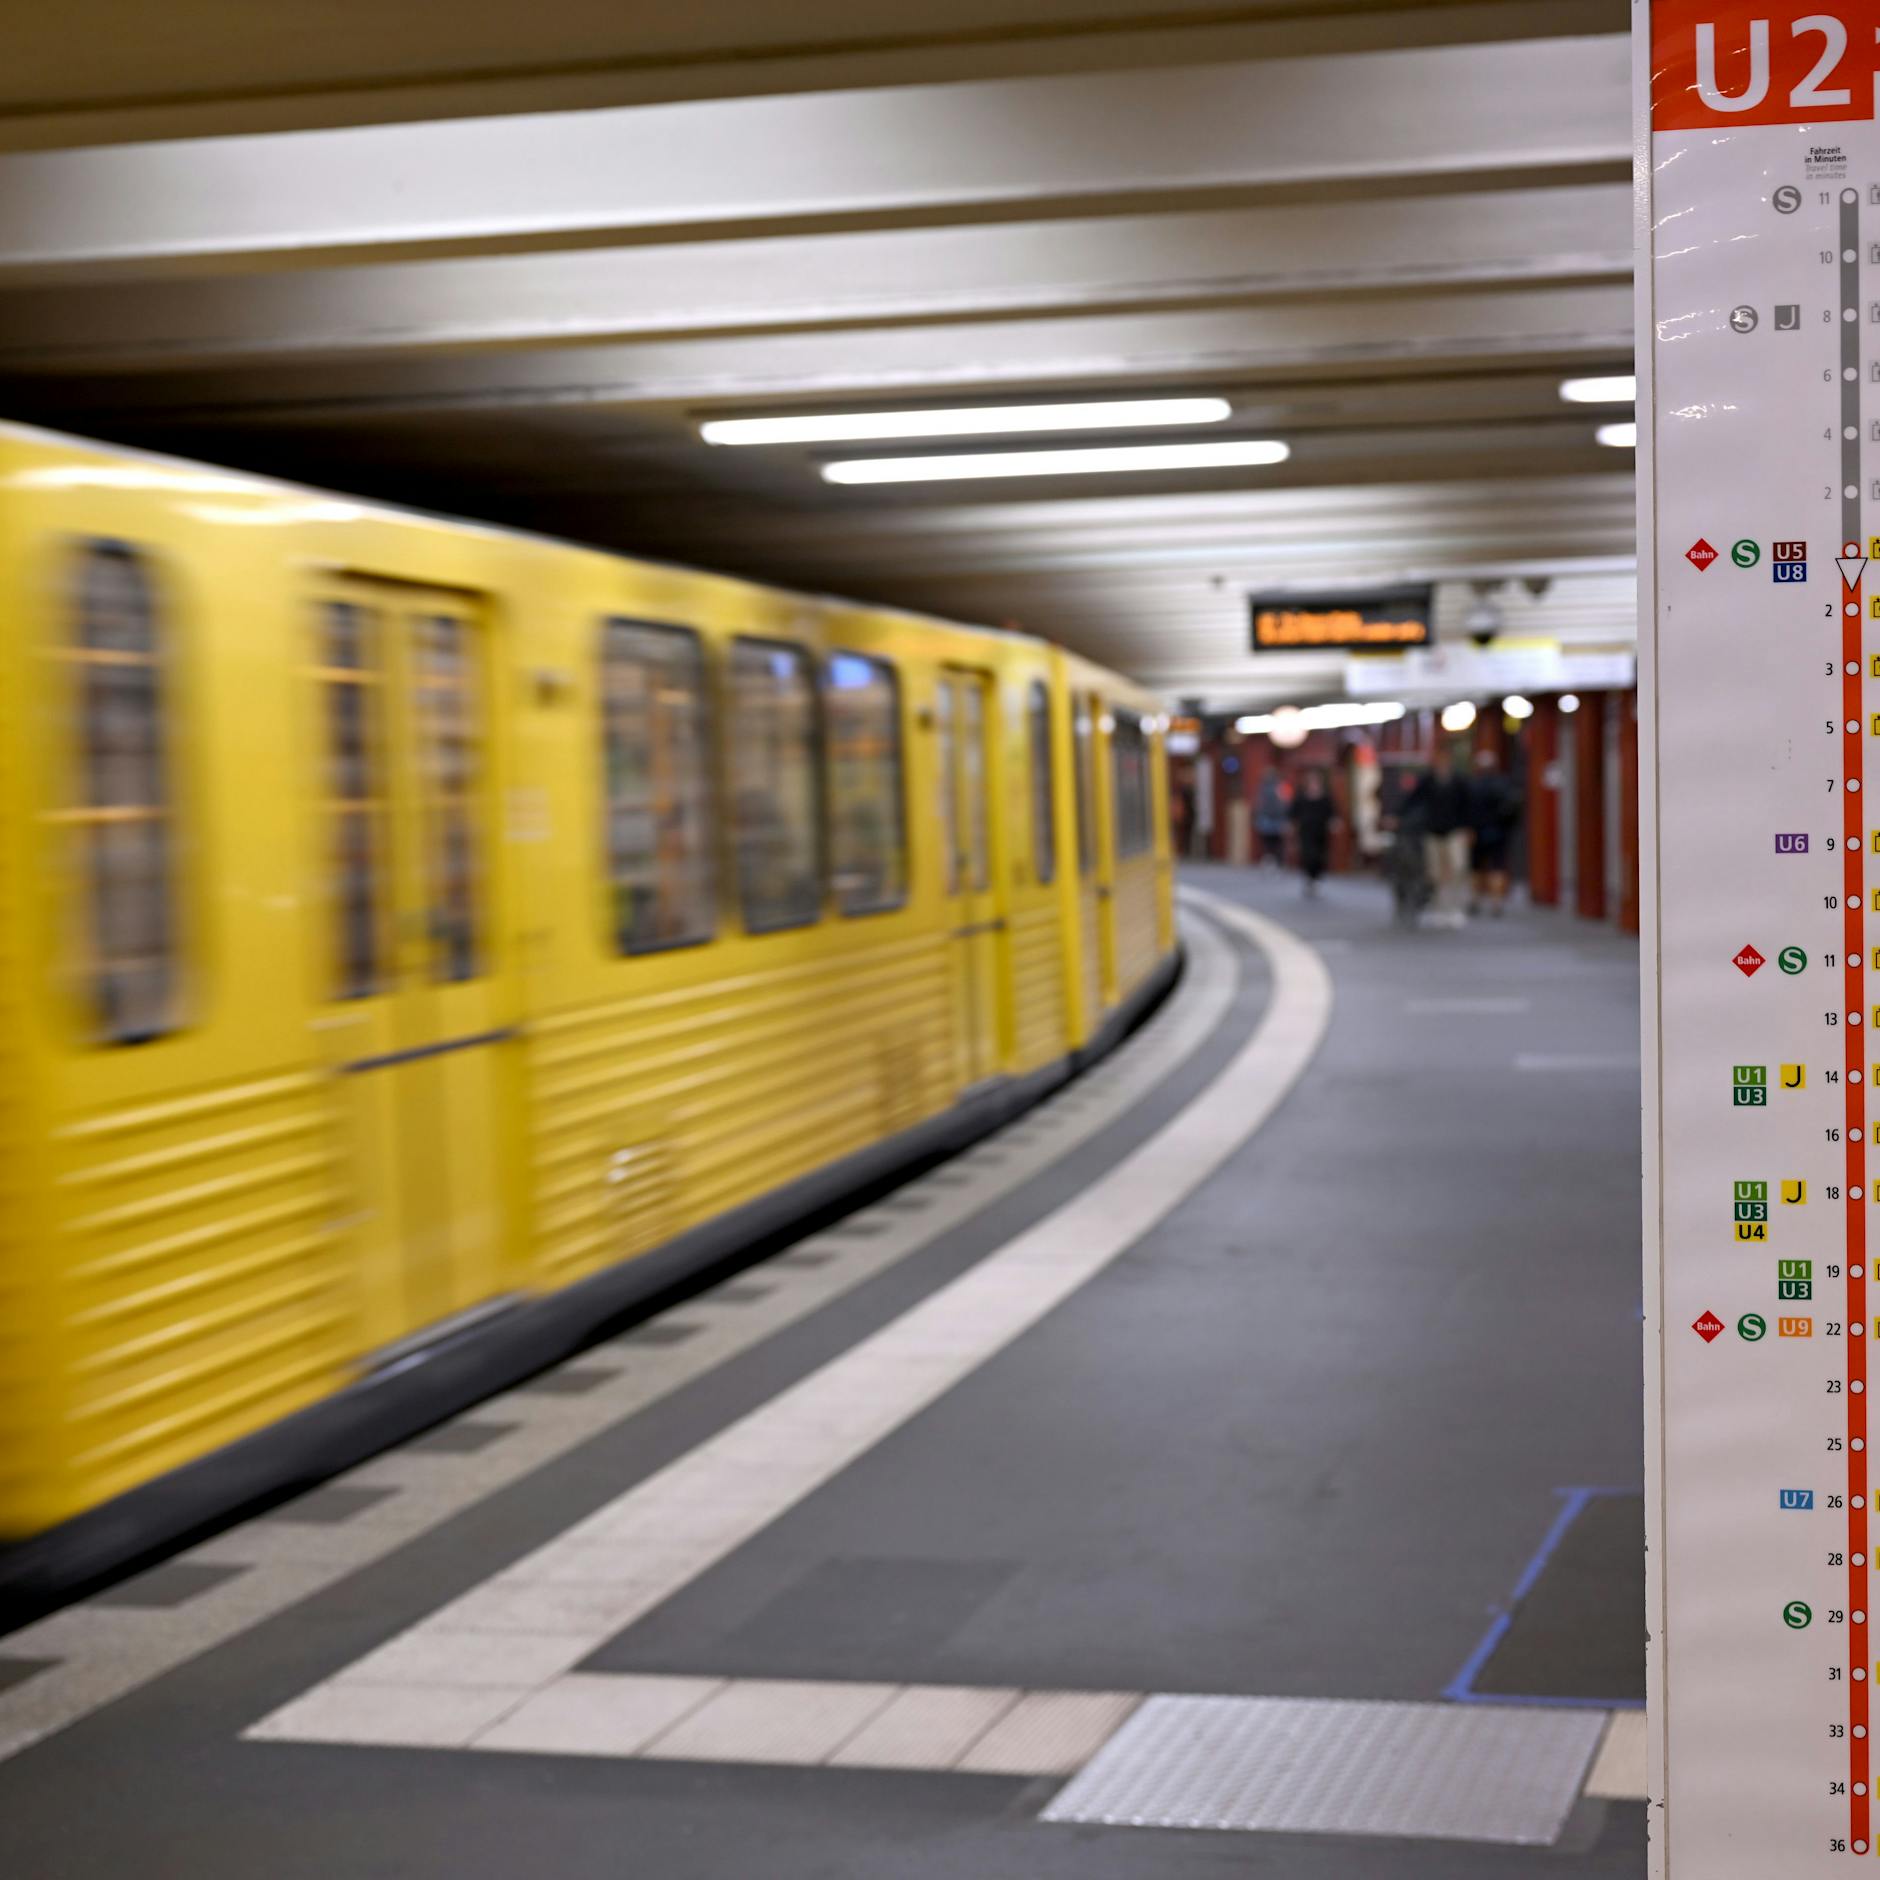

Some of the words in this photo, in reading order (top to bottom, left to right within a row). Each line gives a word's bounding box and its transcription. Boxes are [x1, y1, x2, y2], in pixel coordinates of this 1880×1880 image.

[1695, 14, 1851, 113] U2
[1809, 147, 1841, 156] Fahrzeit
[1804, 154, 1813, 164] in
[1814, 154, 1847, 163] Minuten
[1819, 191, 1830, 205] 11
[1819, 251, 1833, 265] 10
[1822, 309, 1831, 323] 8
[1823, 368, 1832, 383] 6
[1823, 427, 1832, 441] 4
[1823, 486, 1832, 500] 2
[1690, 549, 1714, 560] Bahn
[1776, 543, 1803, 560] U5
[1777, 564, 1804, 581] U8
[1825, 604, 1833, 617] 2
[1825, 662, 1833, 676] 3
[1826, 720, 1834, 735] 5
[1826, 779, 1834, 793] 7
[1779, 835, 1806, 852] U6
[1826, 838, 1835, 851] 9
[1823, 896, 1838, 909] 10
[1737, 955, 1761, 966] Bahn
[1824, 954, 1835, 968] 11
[1824, 1012, 1838, 1026] 13
[1737, 1068, 1761, 1084] U1
[1825, 1070, 1839, 1084] 14
[1737, 1088, 1763, 1105] U3
[1825, 1128, 1840, 1142] 16
[1738, 1183, 1762, 1199] U1
[1826, 1186, 1840, 1200] 18
[1738, 1203, 1765, 1220] U3
[1738, 1224, 1765, 1240] U4
[1782, 1262, 1807, 1279] U1
[1826, 1264, 1840, 1278] 19
[1782, 1282, 1809, 1298] U3
[1696, 1321, 1720, 1332] Bahn
[1783, 1319, 1809, 1335] U9
[1826, 1322, 1841, 1336] 22
[1826, 1380, 1841, 1394] 23
[1827, 1438, 1842, 1451] 25
[1784, 1492, 1810, 1508] U7
[1827, 1495, 1843, 1509] 26
[1827, 1552, 1843, 1566] 28
[1828, 1610, 1844, 1624] 29
[1828, 1667, 1841, 1681] 31
[1829, 1724, 1844, 1738] 33
[1829, 1782, 1845, 1795] 34
[1830, 1838, 1846, 1852] 36
